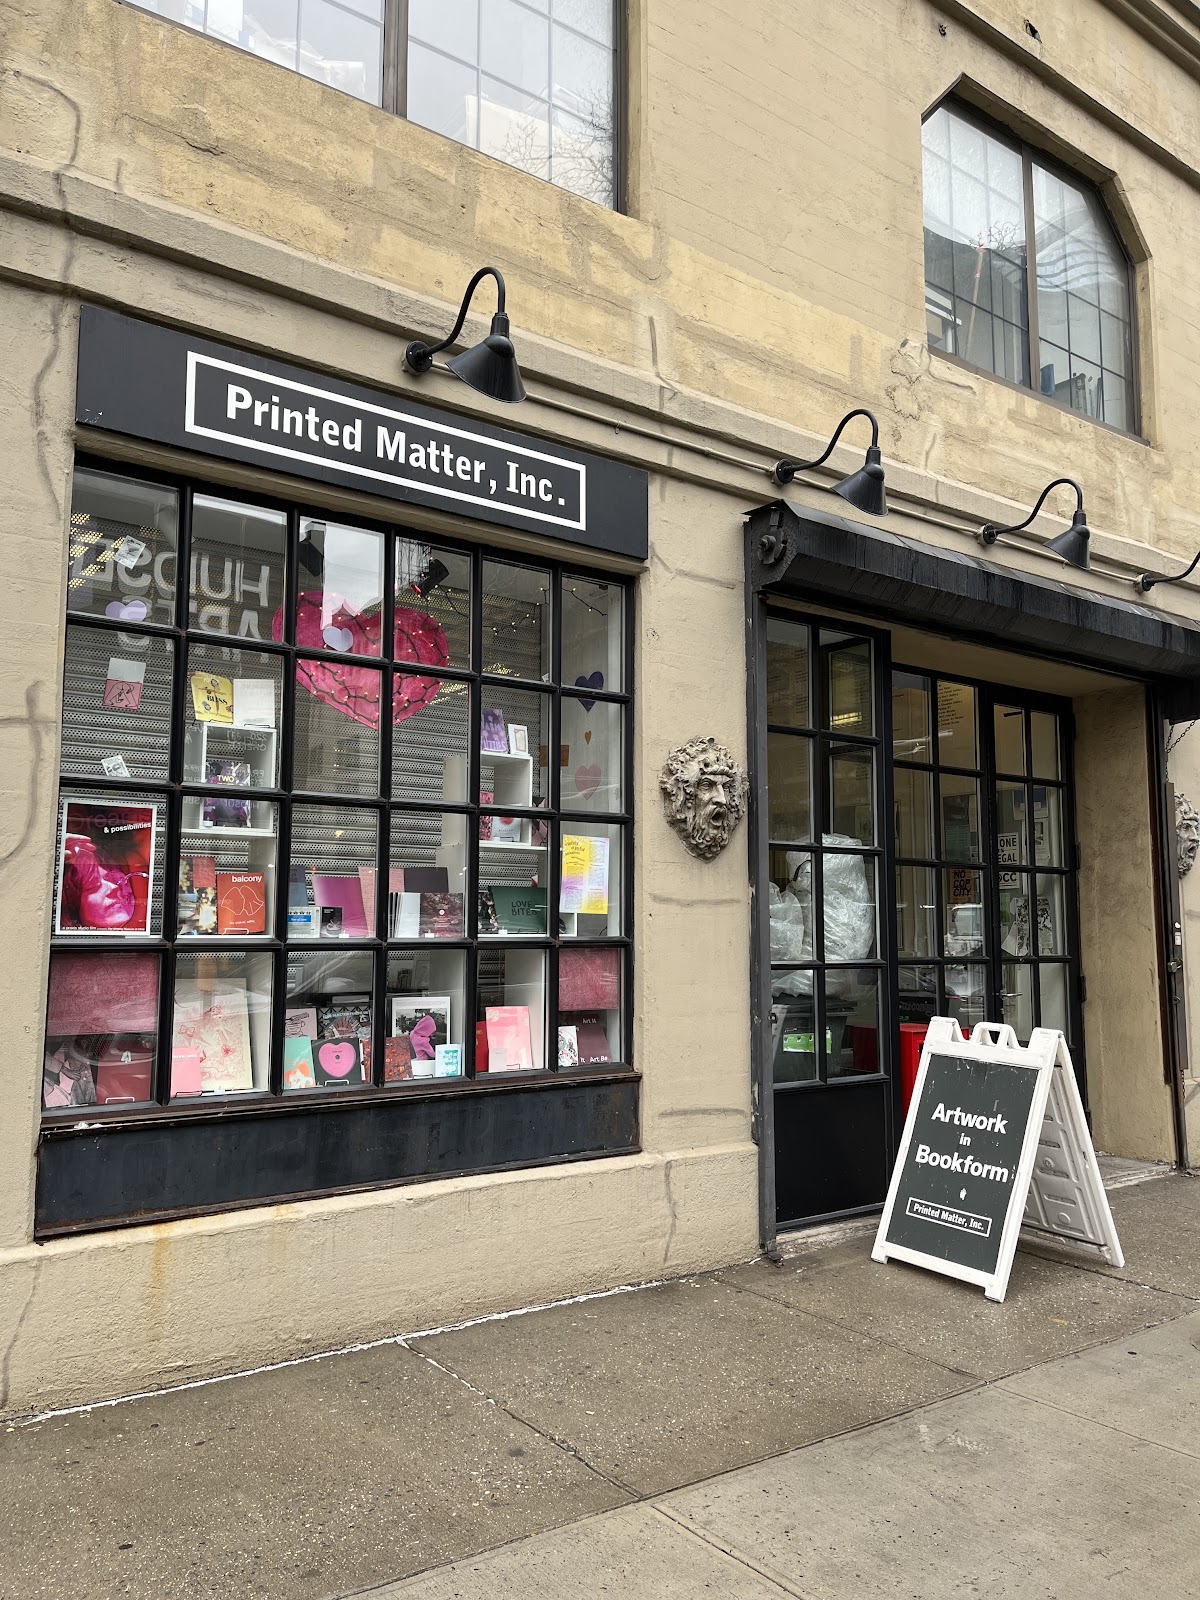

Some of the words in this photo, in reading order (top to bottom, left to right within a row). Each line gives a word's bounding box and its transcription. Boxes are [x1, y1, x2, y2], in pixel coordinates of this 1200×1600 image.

[226, 383, 363, 453] Printed
[376, 425, 498, 494] Matter,
[505, 460, 567, 507] Inc.
[217, 774, 235, 783] TWO
[111, 822, 152, 834] possibilities
[999, 838, 1017, 847] ONE
[998, 853, 1017, 862] EGAL
[231, 875, 263, 883] balcony
[953, 870, 967, 879] NO
[953, 879, 971, 888] COP
[953, 887, 972, 897] CITY
[511, 900, 533, 908] LOVE
[931, 1102, 1009, 1135] Artwork
[959, 1132, 972, 1147] in
[915, 1144, 1009, 1183] Bookform
[913, 1203, 940, 1219] Printed
[941, 1210, 967, 1228] Matter,
[968, 1217, 984, 1231] Inc.
